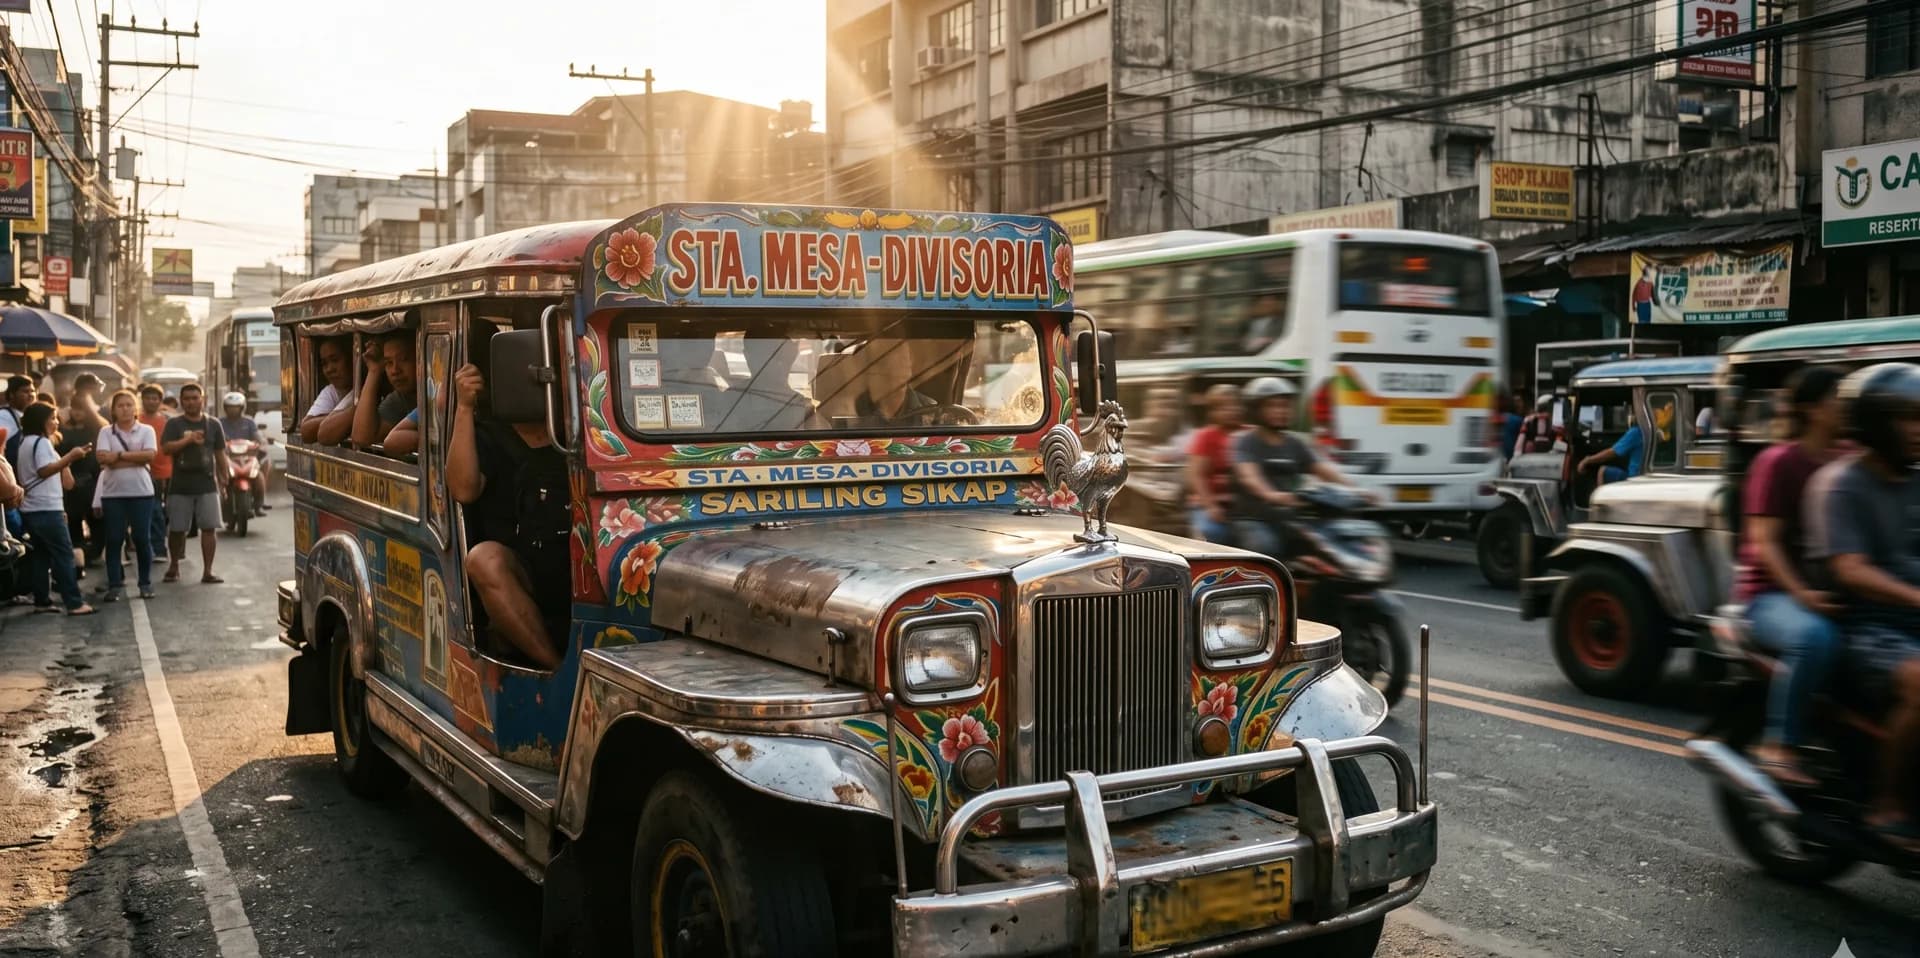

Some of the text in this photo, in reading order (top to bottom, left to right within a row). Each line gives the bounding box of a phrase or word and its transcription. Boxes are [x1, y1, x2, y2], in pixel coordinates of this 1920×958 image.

[1495, 167, 1524, 187] SHOP
[667, 228, 1050, 299] STA. MESA-DIVISORIA
[769, 459, 1018, 482] MESA-DIVISORIA
[701, 480, 1008, 515] SARILING SIKAP
